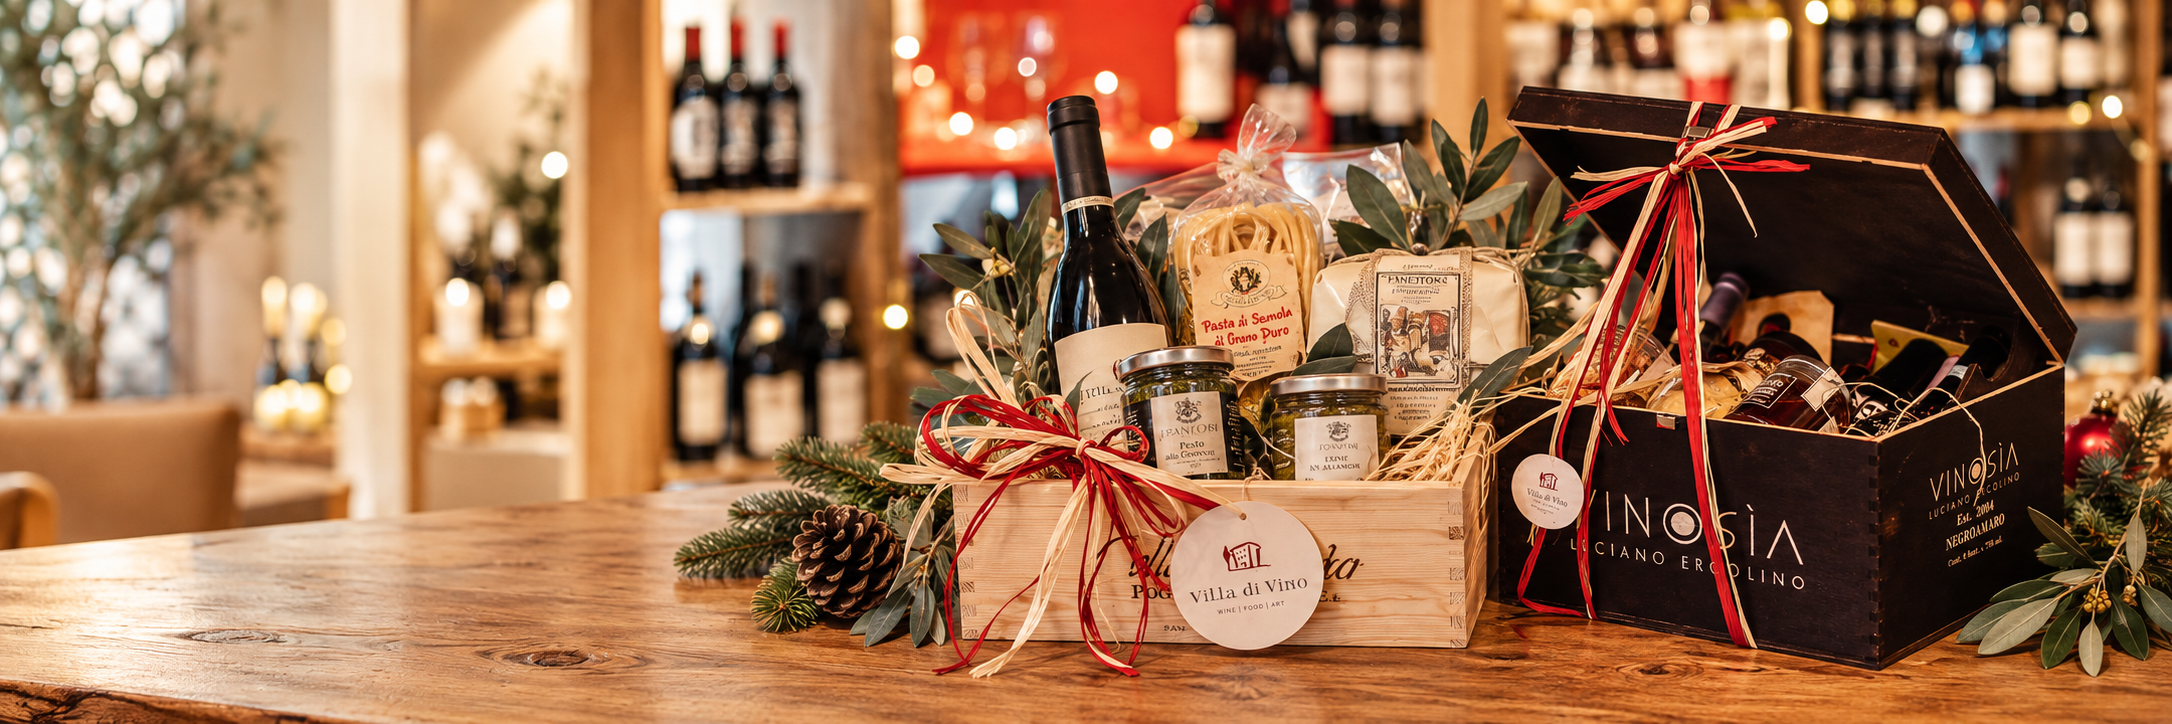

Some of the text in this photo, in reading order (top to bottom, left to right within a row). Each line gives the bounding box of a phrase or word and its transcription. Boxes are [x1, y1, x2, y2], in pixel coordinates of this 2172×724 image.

[1201, 319, 1235, 333] Pasta
[1251, 306, 1293, 325] Semola
[1227, 332, 1258, 346] Grano
[1260, 327, 1289, 344] Duro
[1928, 494, 1971, 521] LUCIANO
[1945, 512, 2005, 551] NEGROAMARO
[1242, 582, 1260, 597] di
[1217, 600, 1285, 615] WINE FOOD ART
